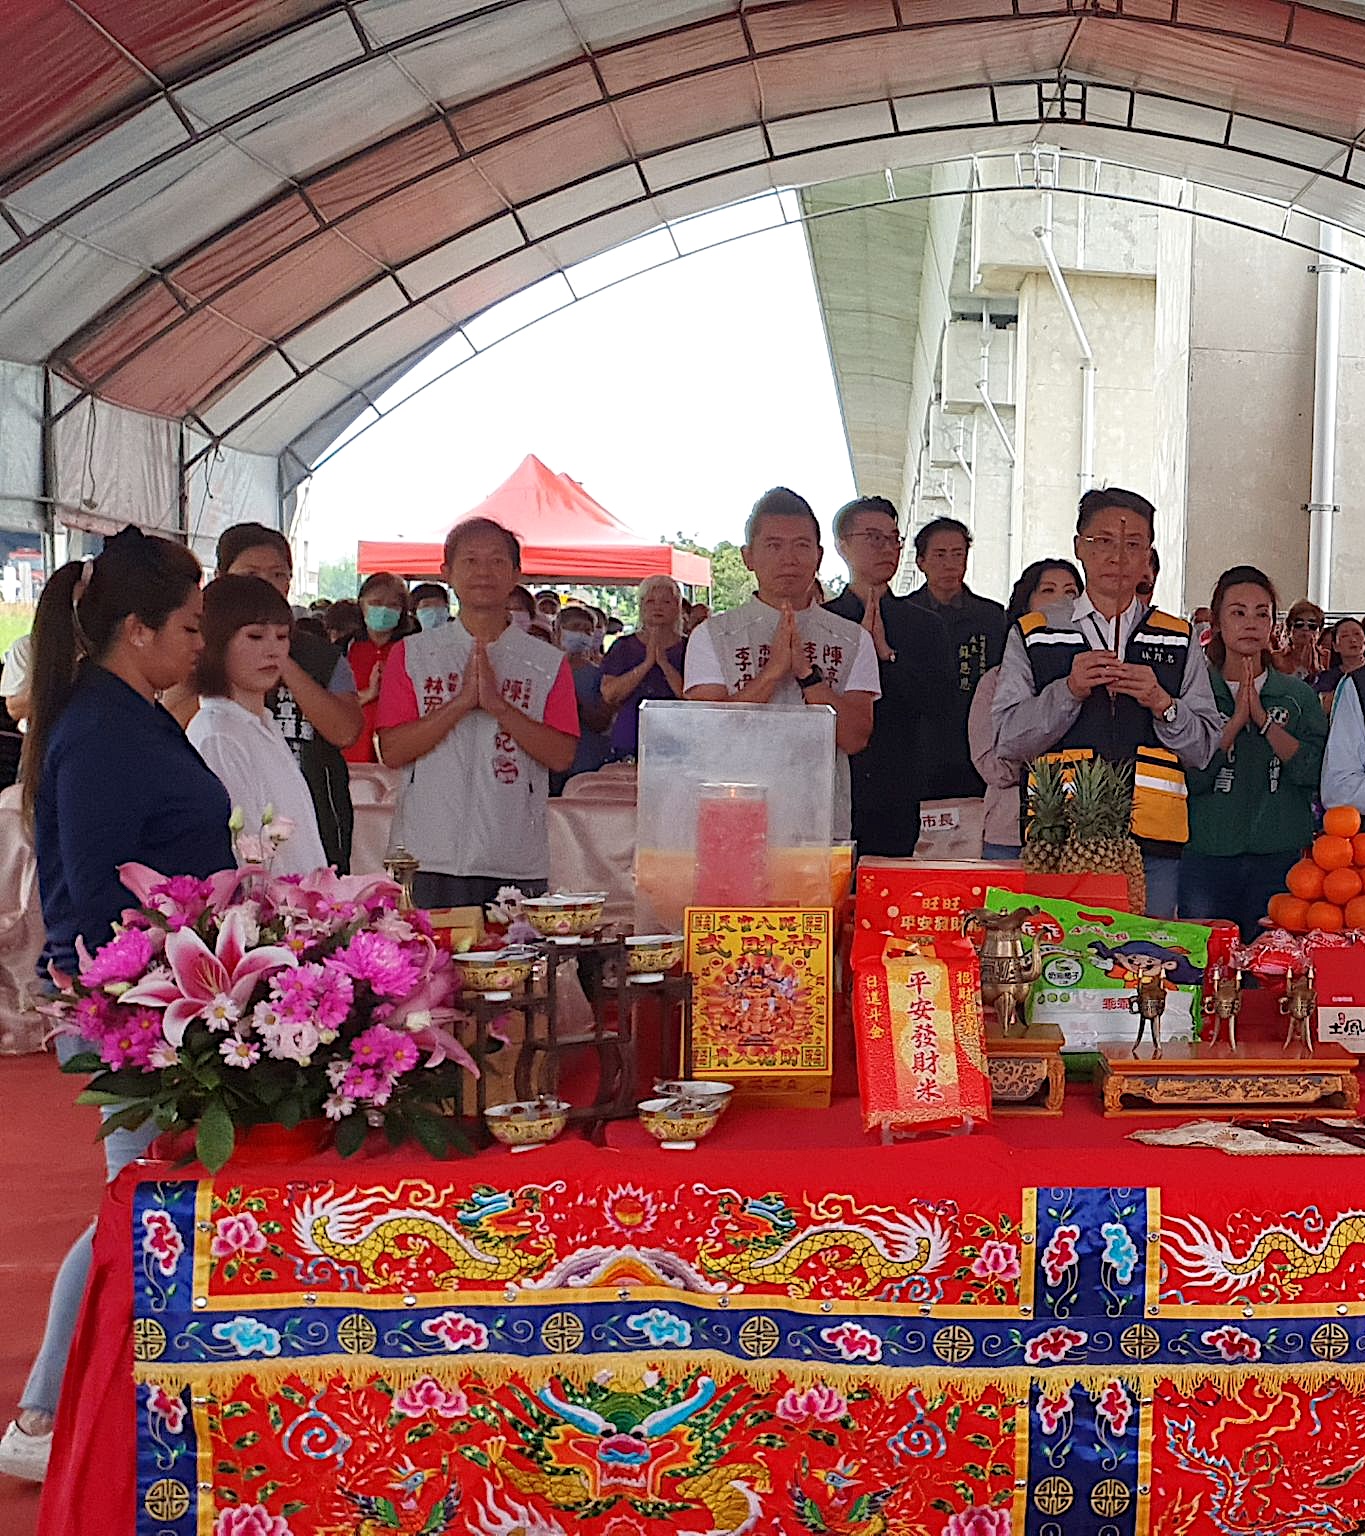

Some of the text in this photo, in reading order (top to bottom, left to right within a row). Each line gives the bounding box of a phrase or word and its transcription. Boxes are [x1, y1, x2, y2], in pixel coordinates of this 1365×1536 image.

[921, 813, 954, 828] 市長
[922, 896, 961, 911] 旺旺
[906, 970, 943, 1103] 平安發財米
